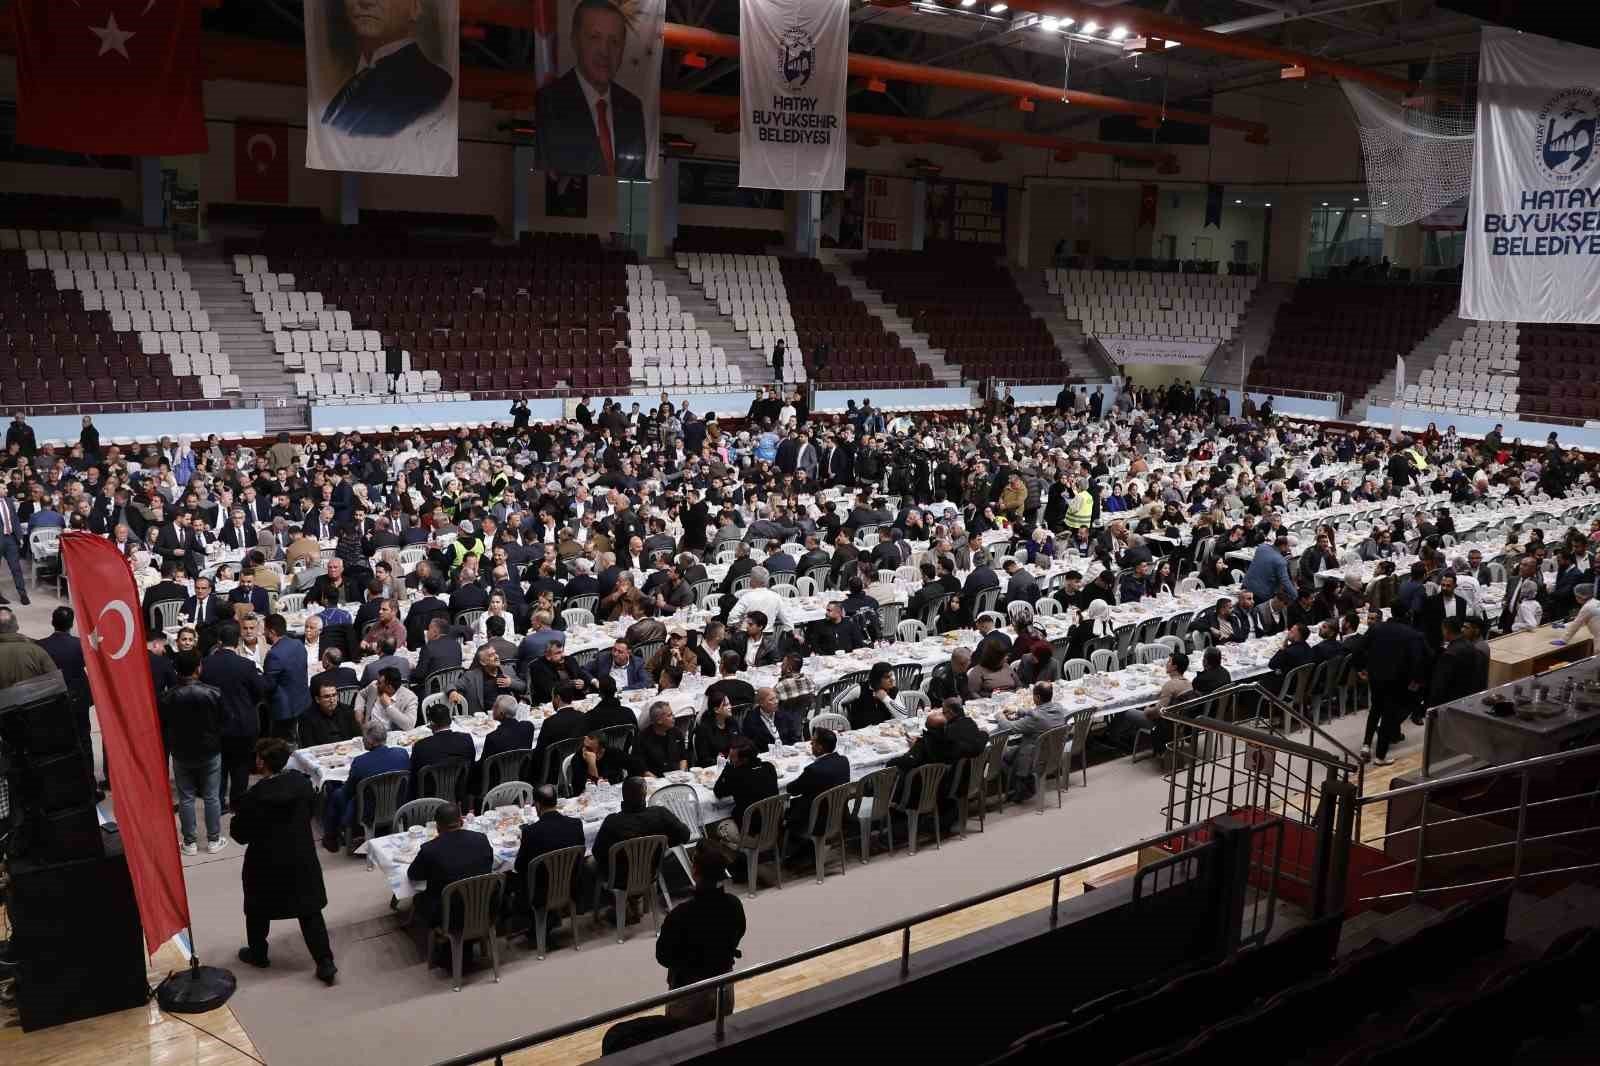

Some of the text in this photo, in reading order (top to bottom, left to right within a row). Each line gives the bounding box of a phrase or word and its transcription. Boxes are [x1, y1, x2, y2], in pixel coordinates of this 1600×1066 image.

[773, 95, 818, 111] HATAY
[1521, 187, 1600, 210] HATAY
[1484, 211, 1600, 233] BÜYÜKŞE
